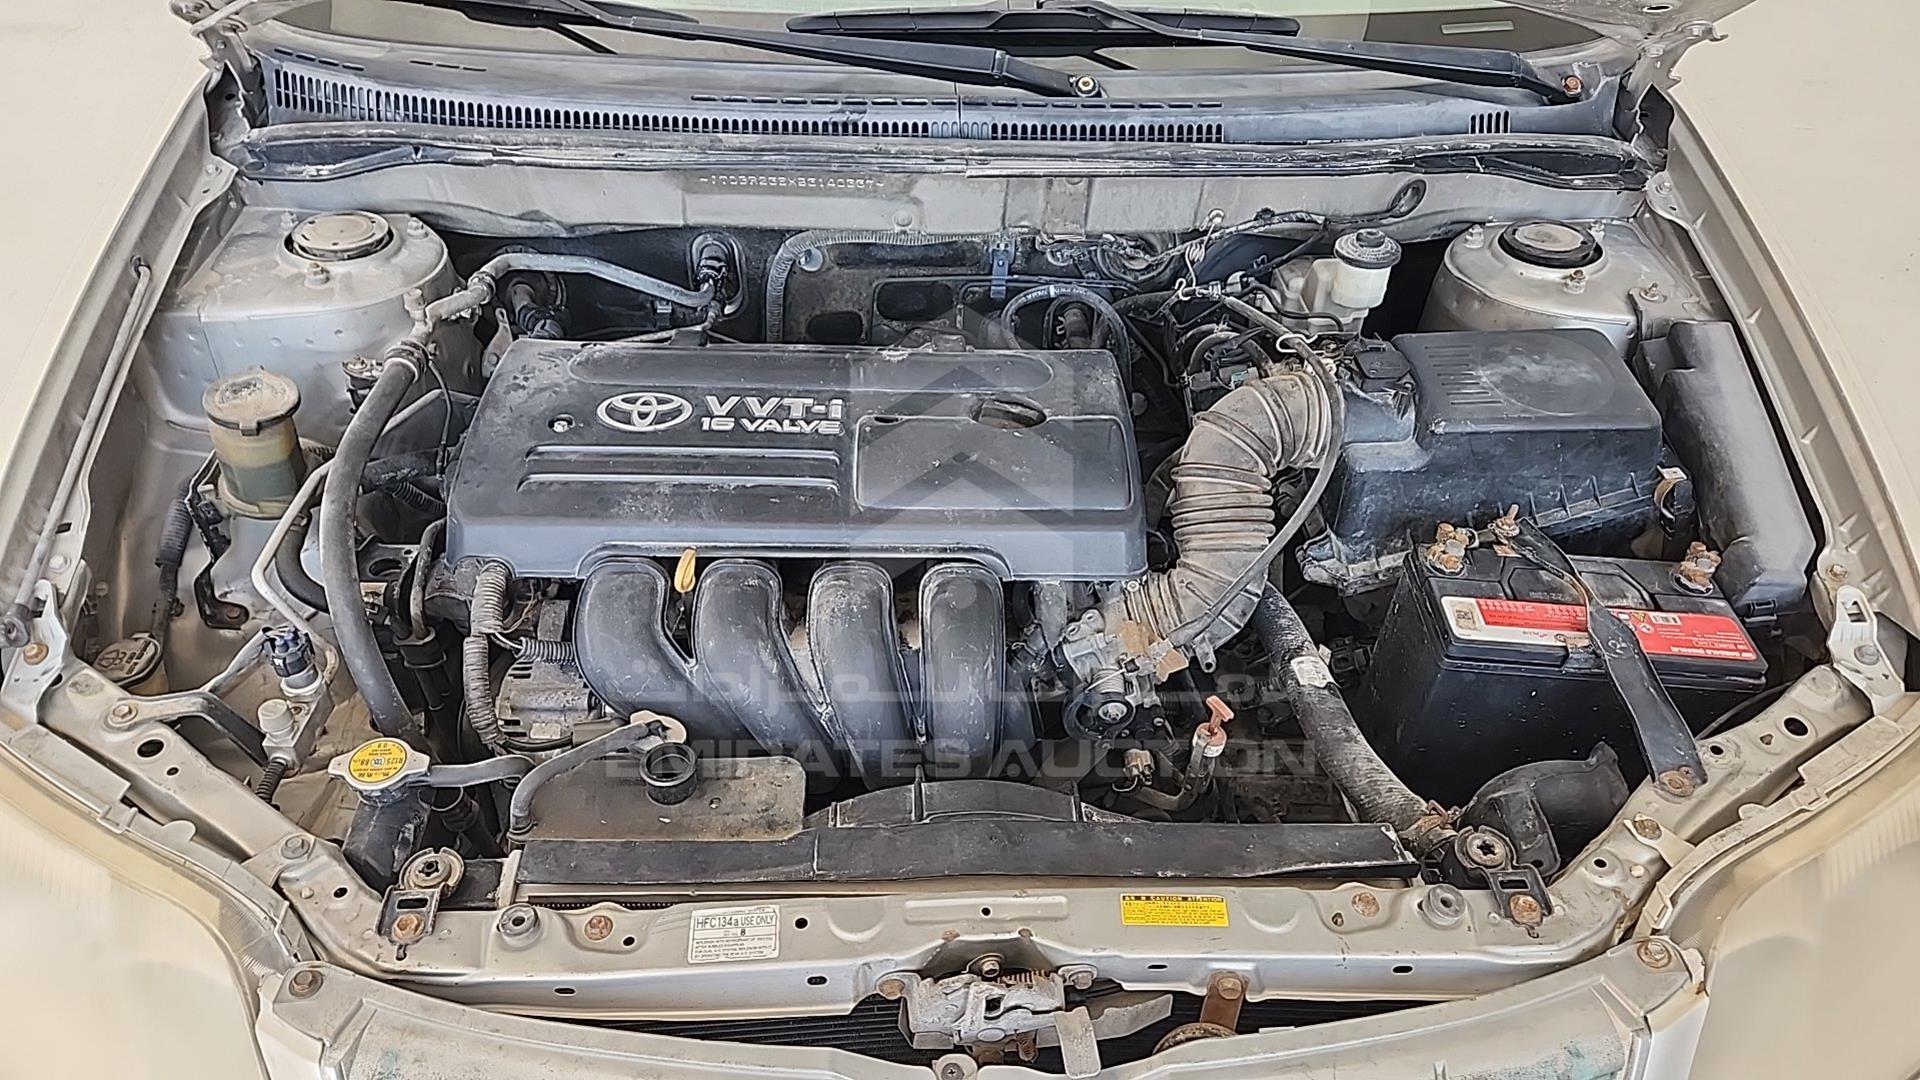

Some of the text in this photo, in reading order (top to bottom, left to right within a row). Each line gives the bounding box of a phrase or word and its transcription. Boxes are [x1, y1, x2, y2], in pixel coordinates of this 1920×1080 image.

[705, 395, 845, 419] VVT-i
[701, 416, 844, 434] 16 VALVE
[696, 914, 775, 929] HFC134a USE ONLY
